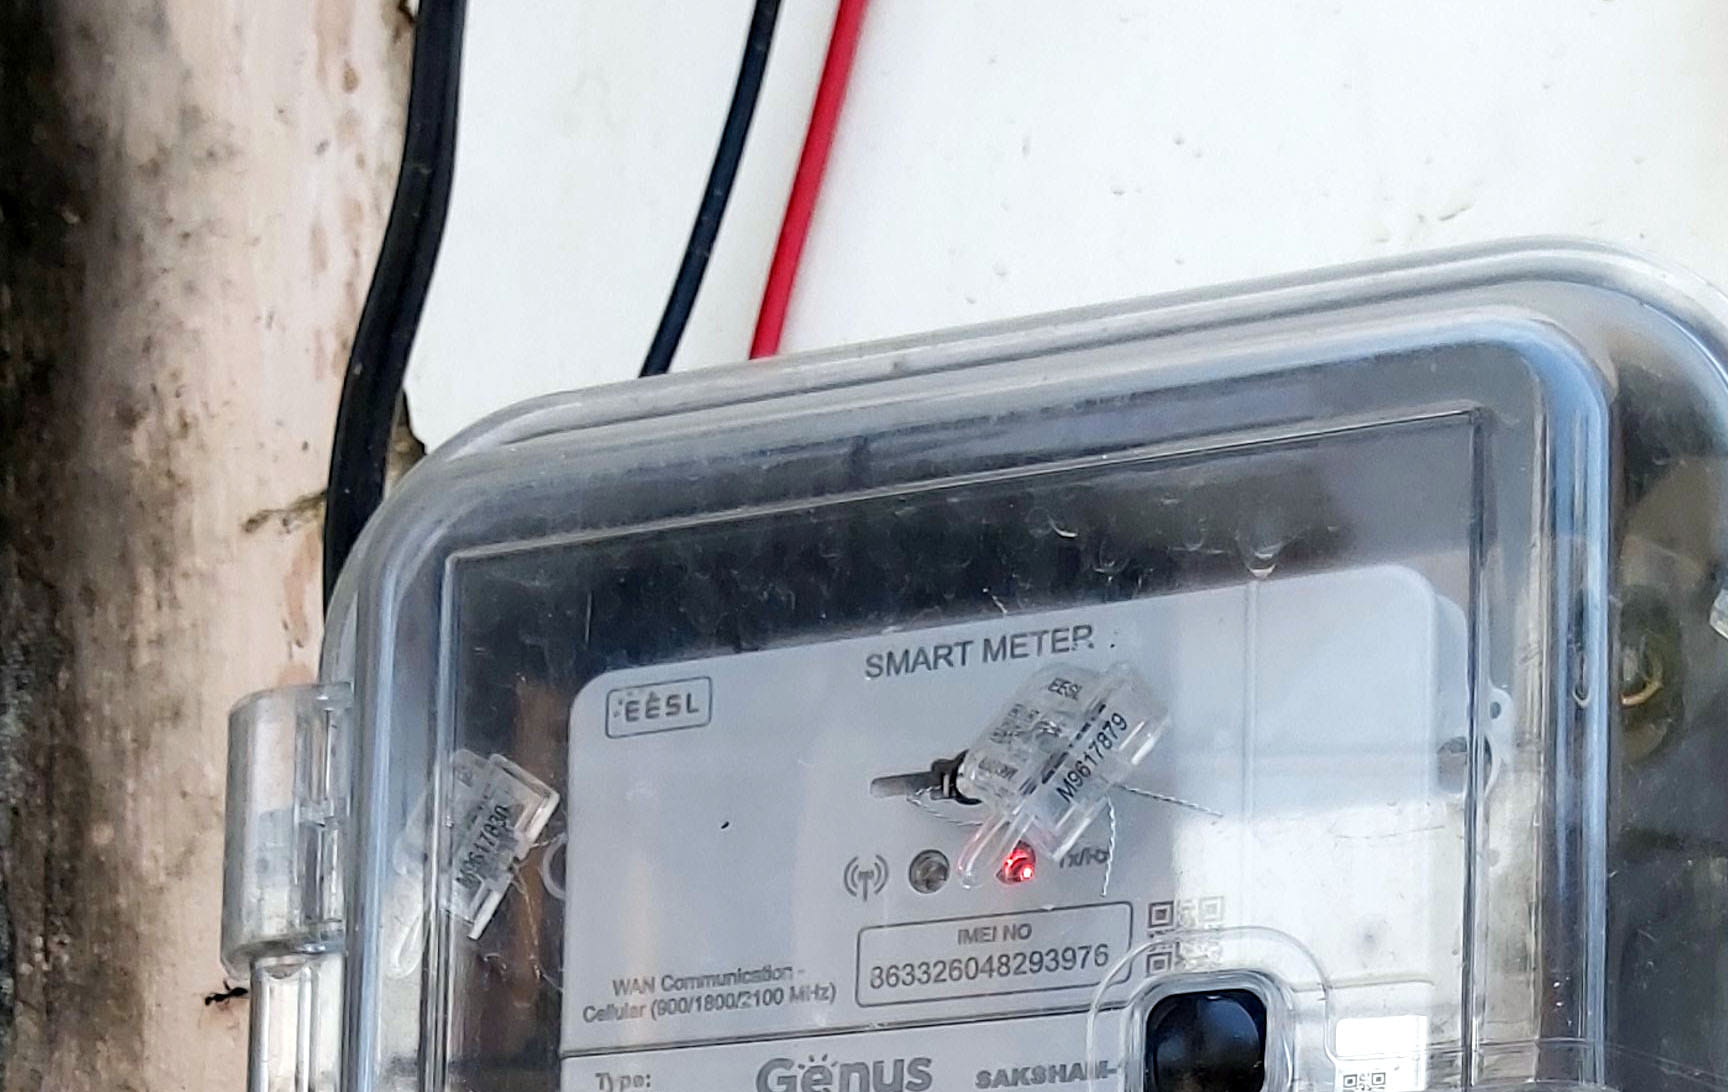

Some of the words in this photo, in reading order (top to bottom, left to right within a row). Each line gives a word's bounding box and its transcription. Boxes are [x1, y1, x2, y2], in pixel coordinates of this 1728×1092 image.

[865, 640, 974, 678] SMART
[982, 624, 1095, 663] METER
[624, 690, 700, 722] EESL
[1055, 711, 1128, 804] M9617879
[957, 926, 997, 945] IMEI
[1002, 922, 1033, 941] NO
[612, 976, 655, 997] WAN
[660, 965, 793, 992] Communication
[869, 943, 1110, 989] 863326048293976
